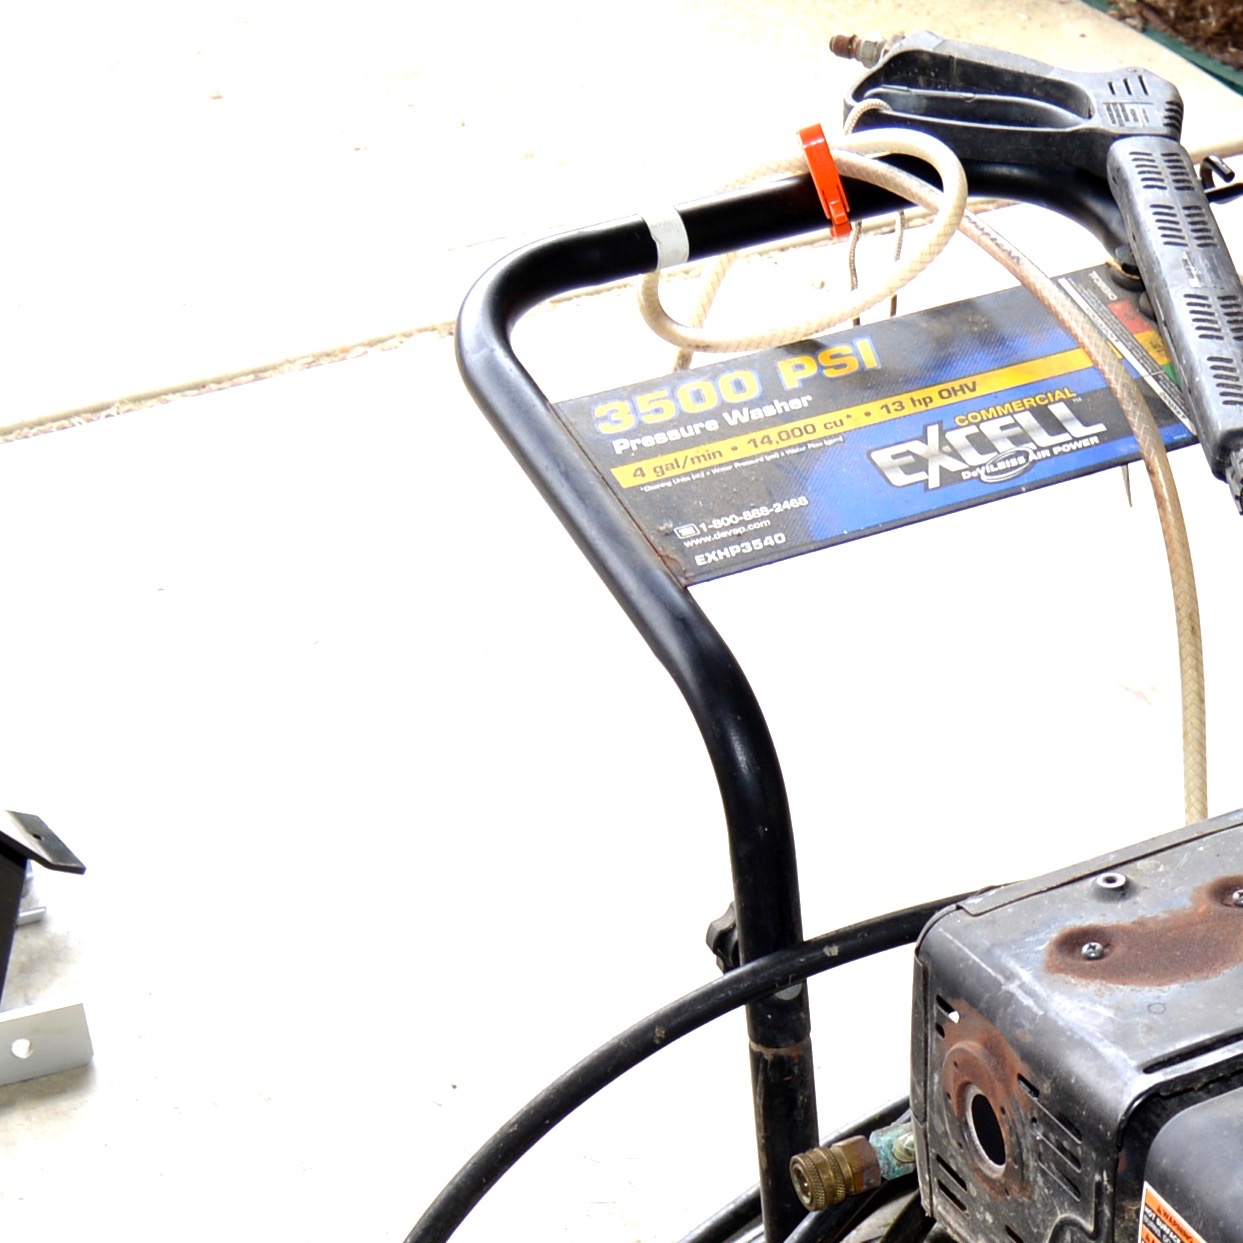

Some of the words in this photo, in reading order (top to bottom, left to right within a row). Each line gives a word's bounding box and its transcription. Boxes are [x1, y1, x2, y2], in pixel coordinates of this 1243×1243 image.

[593, 368, 762, 434] 3500
[777, 339, 879, 391] PSI
[954, 387, 1077, 427] COMMERCIAL
[612, 419, 719, 454] Pressure
[722, 395, 813, 426] Washer
[632, 467, 646, 479] 4
[652, 450, 723, 477] gal/min
[747, 424, 817, 449] 14,000
[880, 401, 905, 415] 13
[911, 395, 934, 407] hp
[937, 381, 978, 400] OHV
[870, 402, 1107, 490] EXCELL
[1028, 448, 1051, 461] AIR
[1052, 436, 1100, 455] POWER
[683, 519, 771, 548] www.devap.com
[694, 532, 787, 566] EXHP3540
